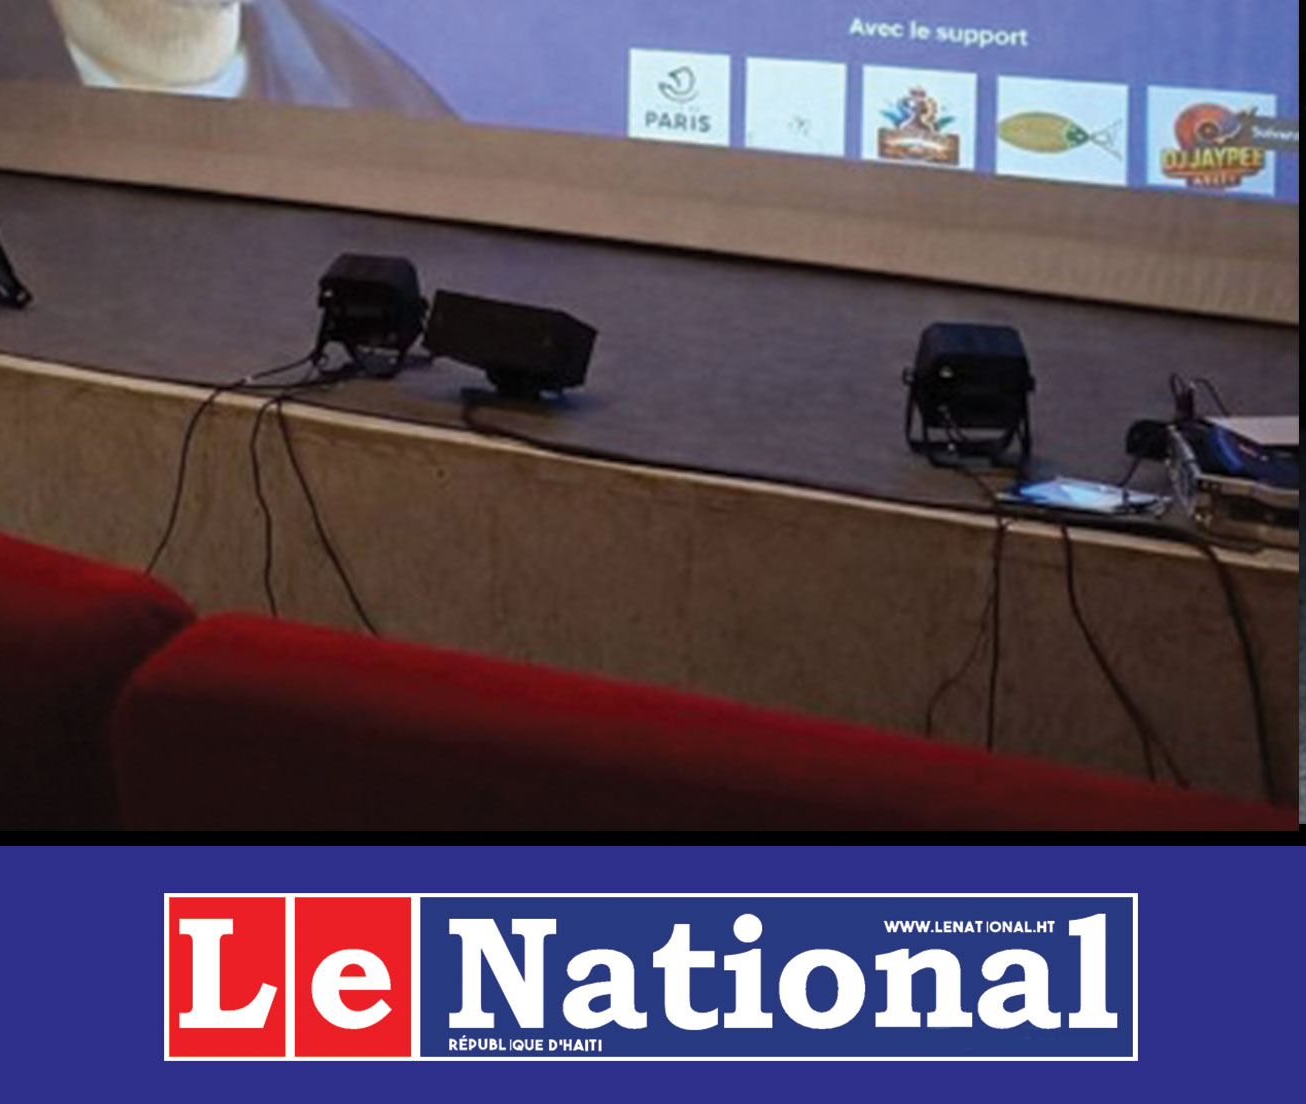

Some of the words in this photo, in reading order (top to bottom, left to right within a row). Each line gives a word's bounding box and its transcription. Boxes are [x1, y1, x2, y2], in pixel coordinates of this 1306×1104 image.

[849, 18, 905, 39] Avec
[910, 21, 931, 42] le
[936, 25, 1028, 48] support
[645, 110, 711, 133] PARIS
